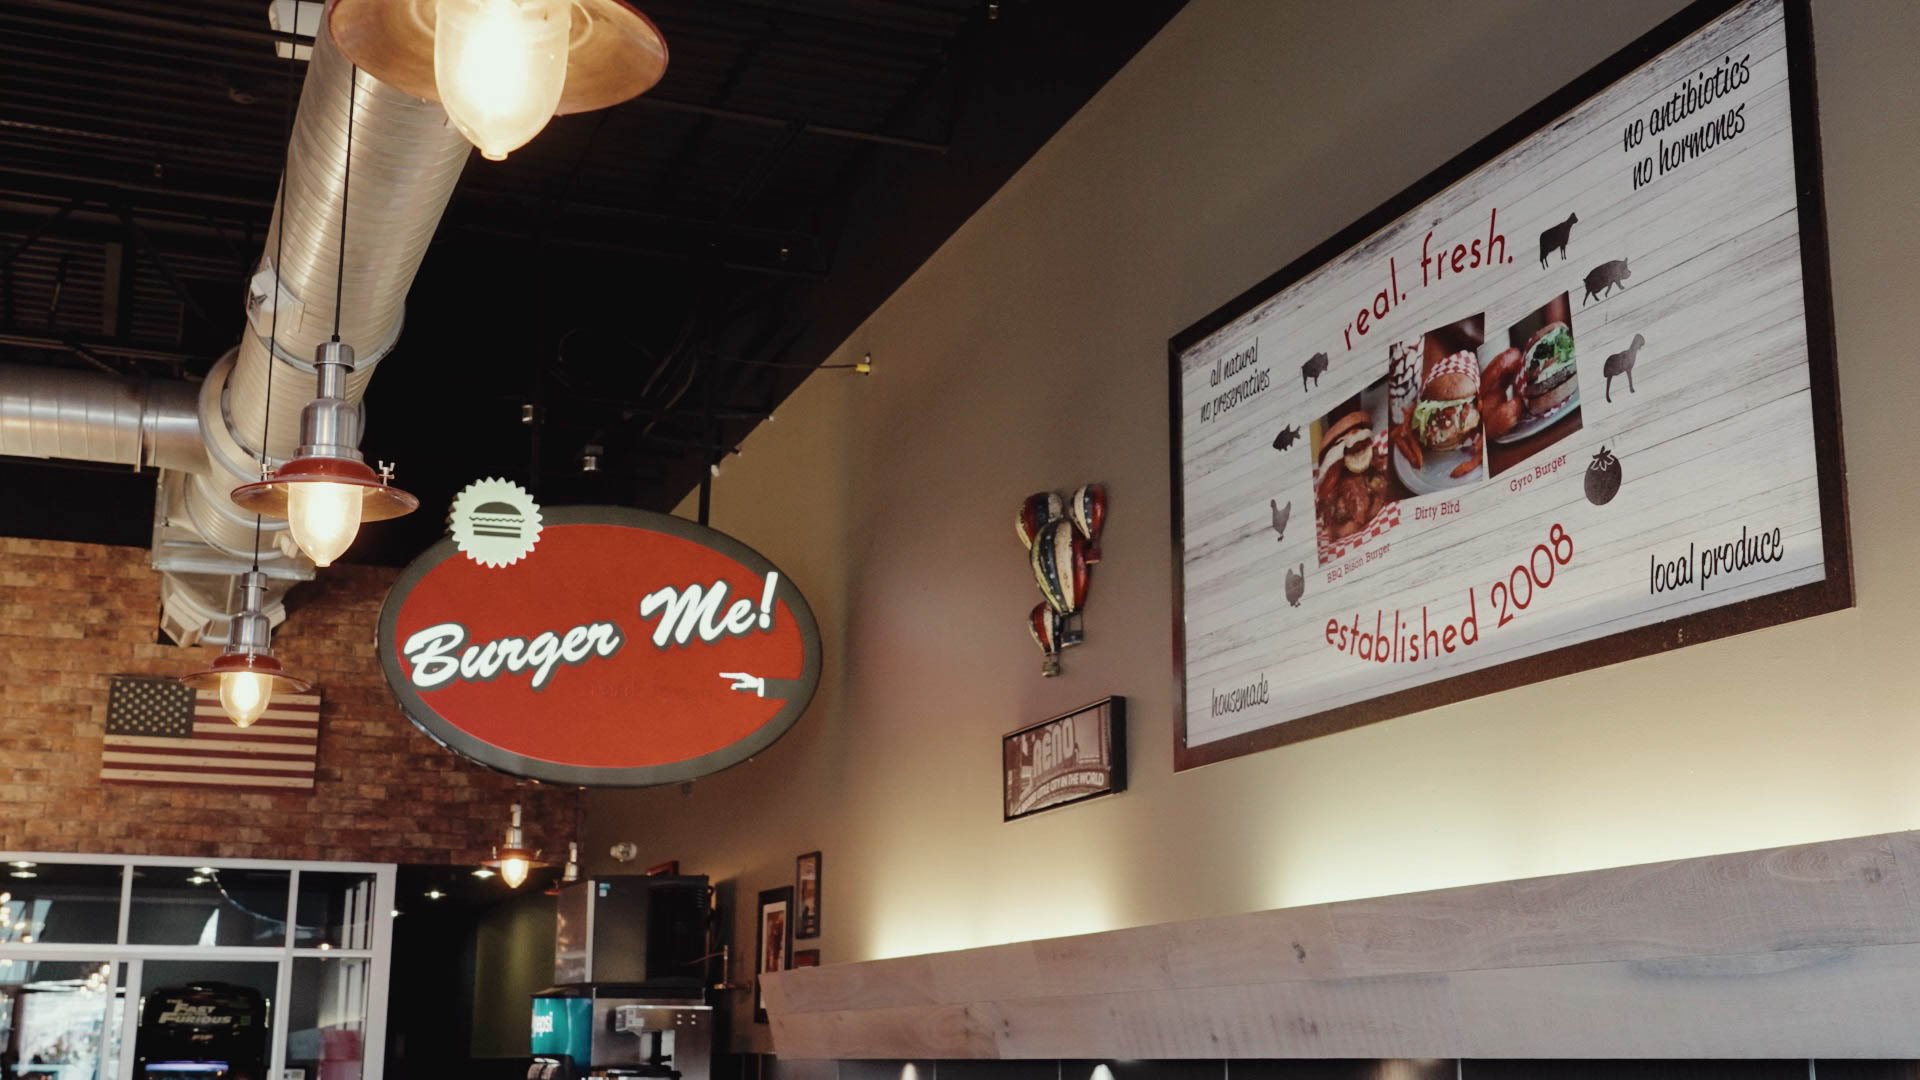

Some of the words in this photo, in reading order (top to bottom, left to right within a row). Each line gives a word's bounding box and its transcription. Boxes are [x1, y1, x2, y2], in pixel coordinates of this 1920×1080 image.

[1623, 118, 1643, 152] no
[1650, 54, 1750, 136] antibiotics
[1633, 157, 1653, 190] no
[1659, 103, 1745, 175] hormones
[1344, 257, 1406, 351] real.
[1421, 208, 1513, 287] fresh.
[1211, 358, 1222, 388] all
[1224, 336, 1258, 380] natural
[1201, 402, 1211, 423] no
[1213, 367, 1270, 423] preservatives
[1510, 472, 1533, 492] Gyro
[1535, 455, 1567, 480] Burger
[1415, 504, 1438, 520] Dirty
[1441, 500, 1460, 516] Bird
[1365, 543, 1390, 563] Burger
[1650, 542, 1693, 594] local
[1701, 526, 1784, 591] produce
[1325, 587, 1479, 663] established
[1491, 523, 1573, 628] 2008
[403, 622, 620, 689] Burger
[640, 571, 778, 647] Me!
[1211, 672, 1269, 718] housemade
[1080, 772, 1104, 786] WORLD
